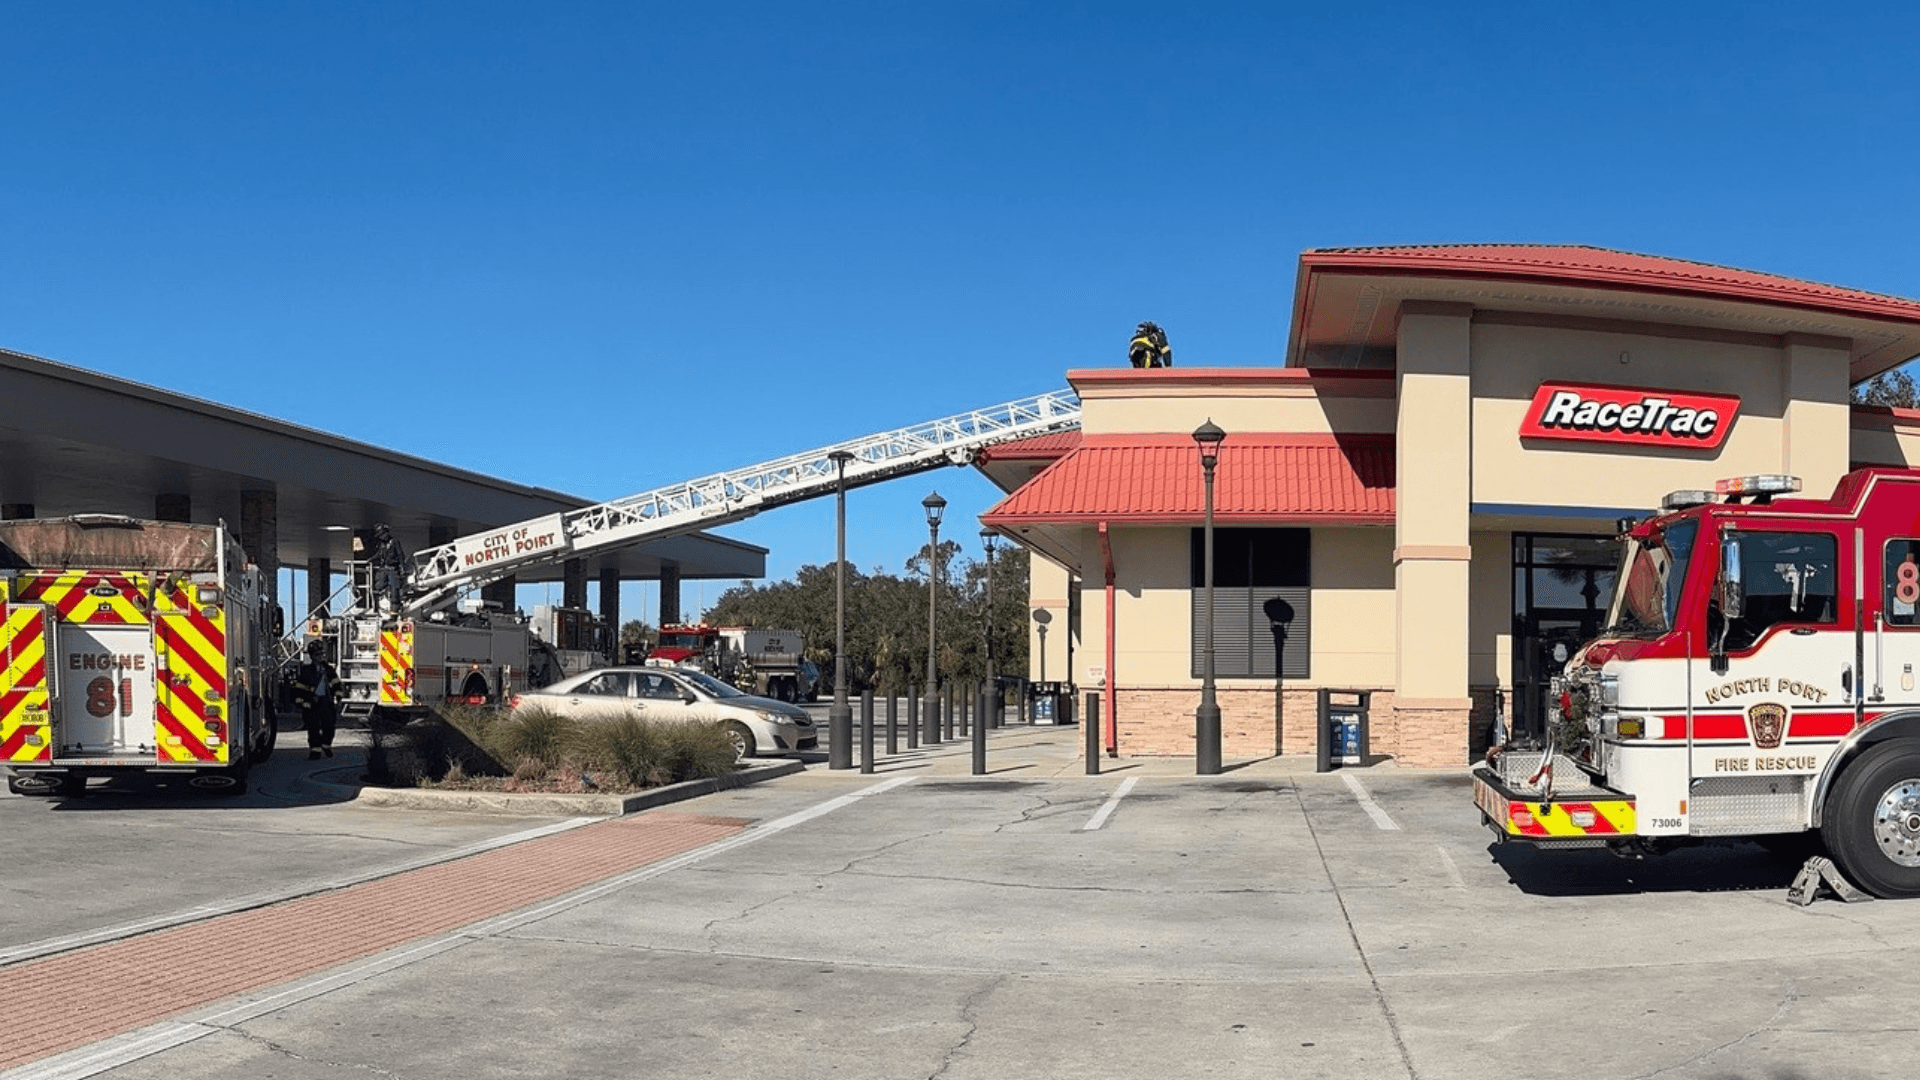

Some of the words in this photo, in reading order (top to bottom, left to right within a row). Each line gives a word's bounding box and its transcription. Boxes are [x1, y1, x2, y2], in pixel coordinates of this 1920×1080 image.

[1541, 390, 1719, 438] RaceTrac
[484, 533, 508, 548] CITY
[512, 528, 528, 541] OF
[465, 545, 510, 566] NORTH
[69, 653, 146, 671] ENGINE
[86, 676, 133, 718] 81
[1705, 677, 1771, 705] NORTH
[1777, 678, 1829, 703] PORT
[1715, 757, 1750, 772] FIRE
[1755, 755, 1817, 771] RESCUE
[1651, 818, 1682, 828] 73006
